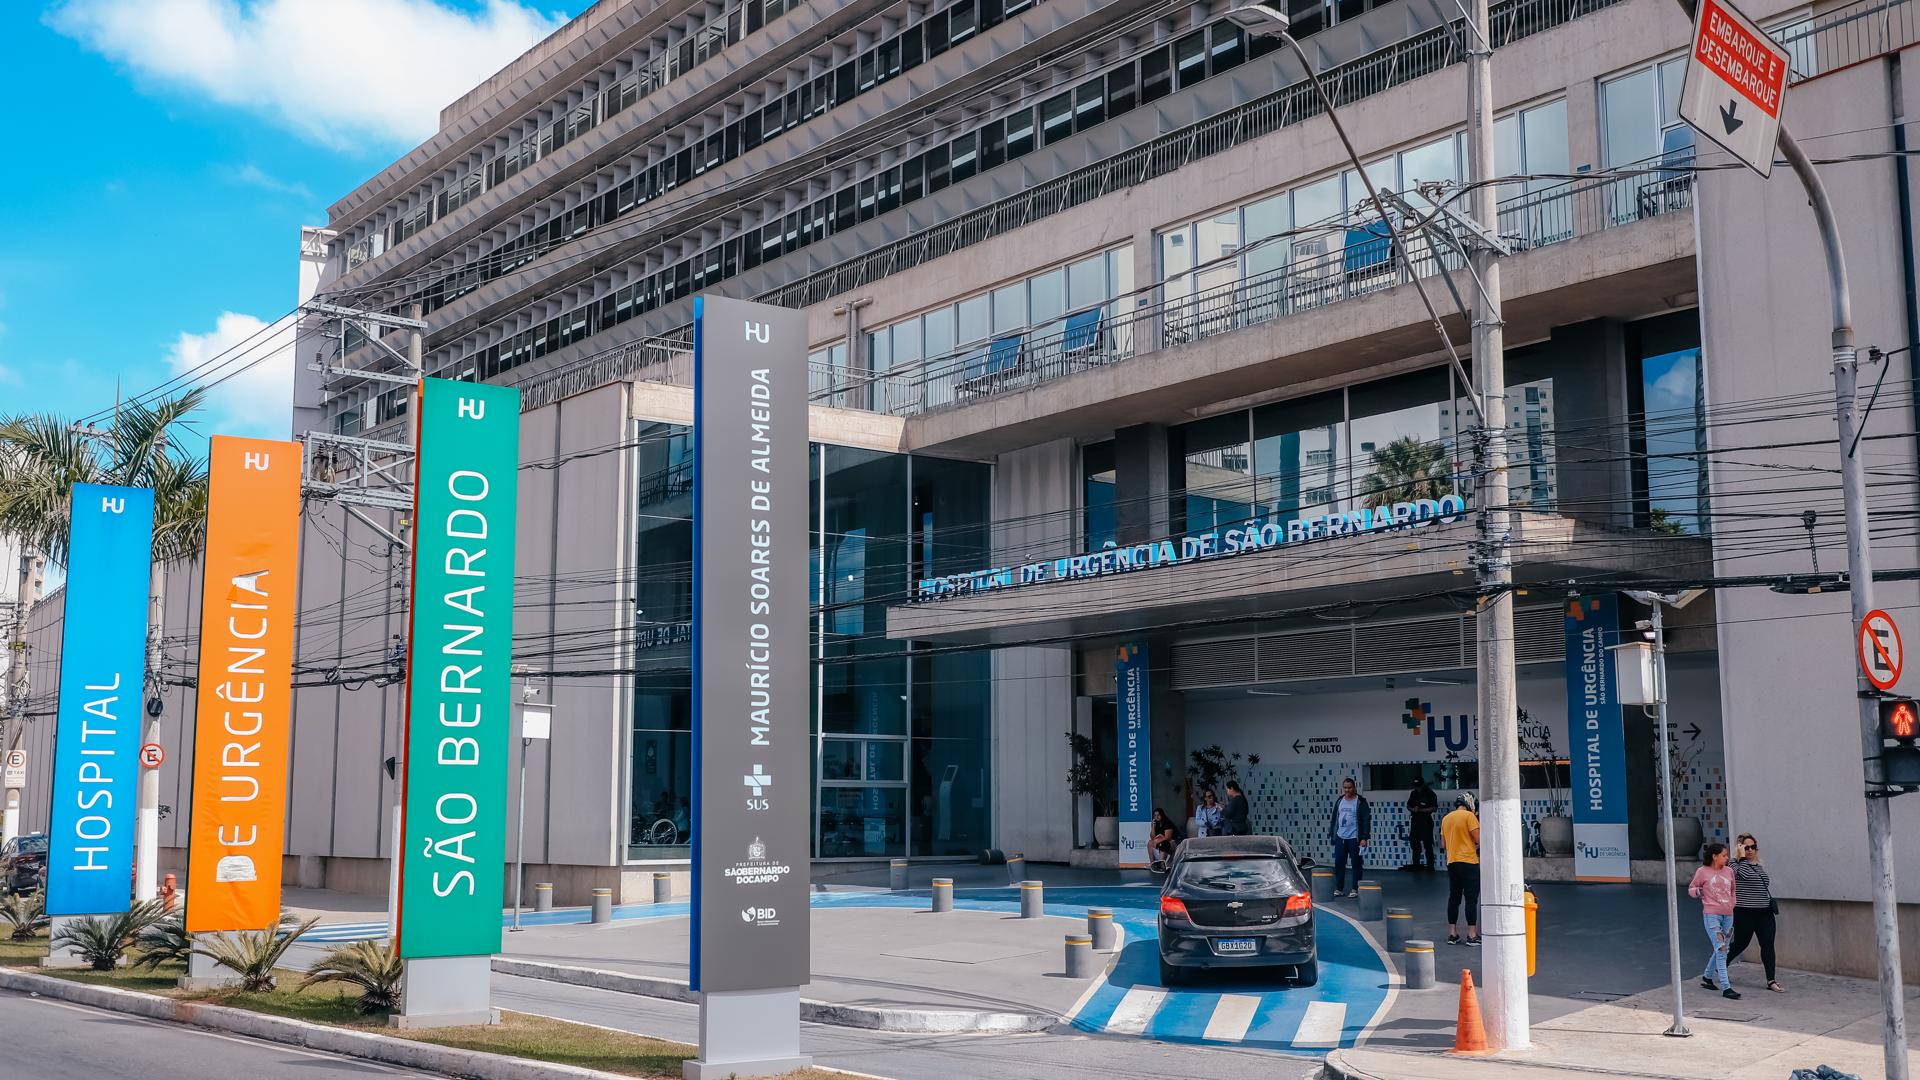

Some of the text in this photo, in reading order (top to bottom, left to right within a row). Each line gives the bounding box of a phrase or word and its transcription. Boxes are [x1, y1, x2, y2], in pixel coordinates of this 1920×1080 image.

[1709, 11, 1776, 80] EMBARQUE E
[1700, 33, 1777, 109] DESEMBARQUE
[745, 321, 770, 344] HU
[458, 398, 485, 420] HU
[245, 452, 270, 471] HU
[102, 497, 125, 514] HU
[746, 368, 770, 746] MAURÍCIO SOARES DE ALMEIDA
[918, 494, 1465, 602] HOSPITAL DE URGÊNCIA DE SÃO BERNARDO
[424, 470, 490, 897] SÃO BERNARDO
[216, 569, 270, 883] DE URGÊNCIA
[1427, 715, 1469, 752] HU
[1581, 627, 1602, 811] HOSPITAL DE URGÊNCIA
[1126, 667, 1138, 812] HOSPITAL DE URGÊNCIA
[1309, 744, 1342, 754] ADULTO
[11, 755, 20, 765] E
[73, 672, 120, 871] HOSPITAL
[747, 799, 769, 811] SUS
[1585, 847, 1599, 859] HU
[736, 875, 780, 884] DOCAMPO
[757, 908, 776, 919] BID
